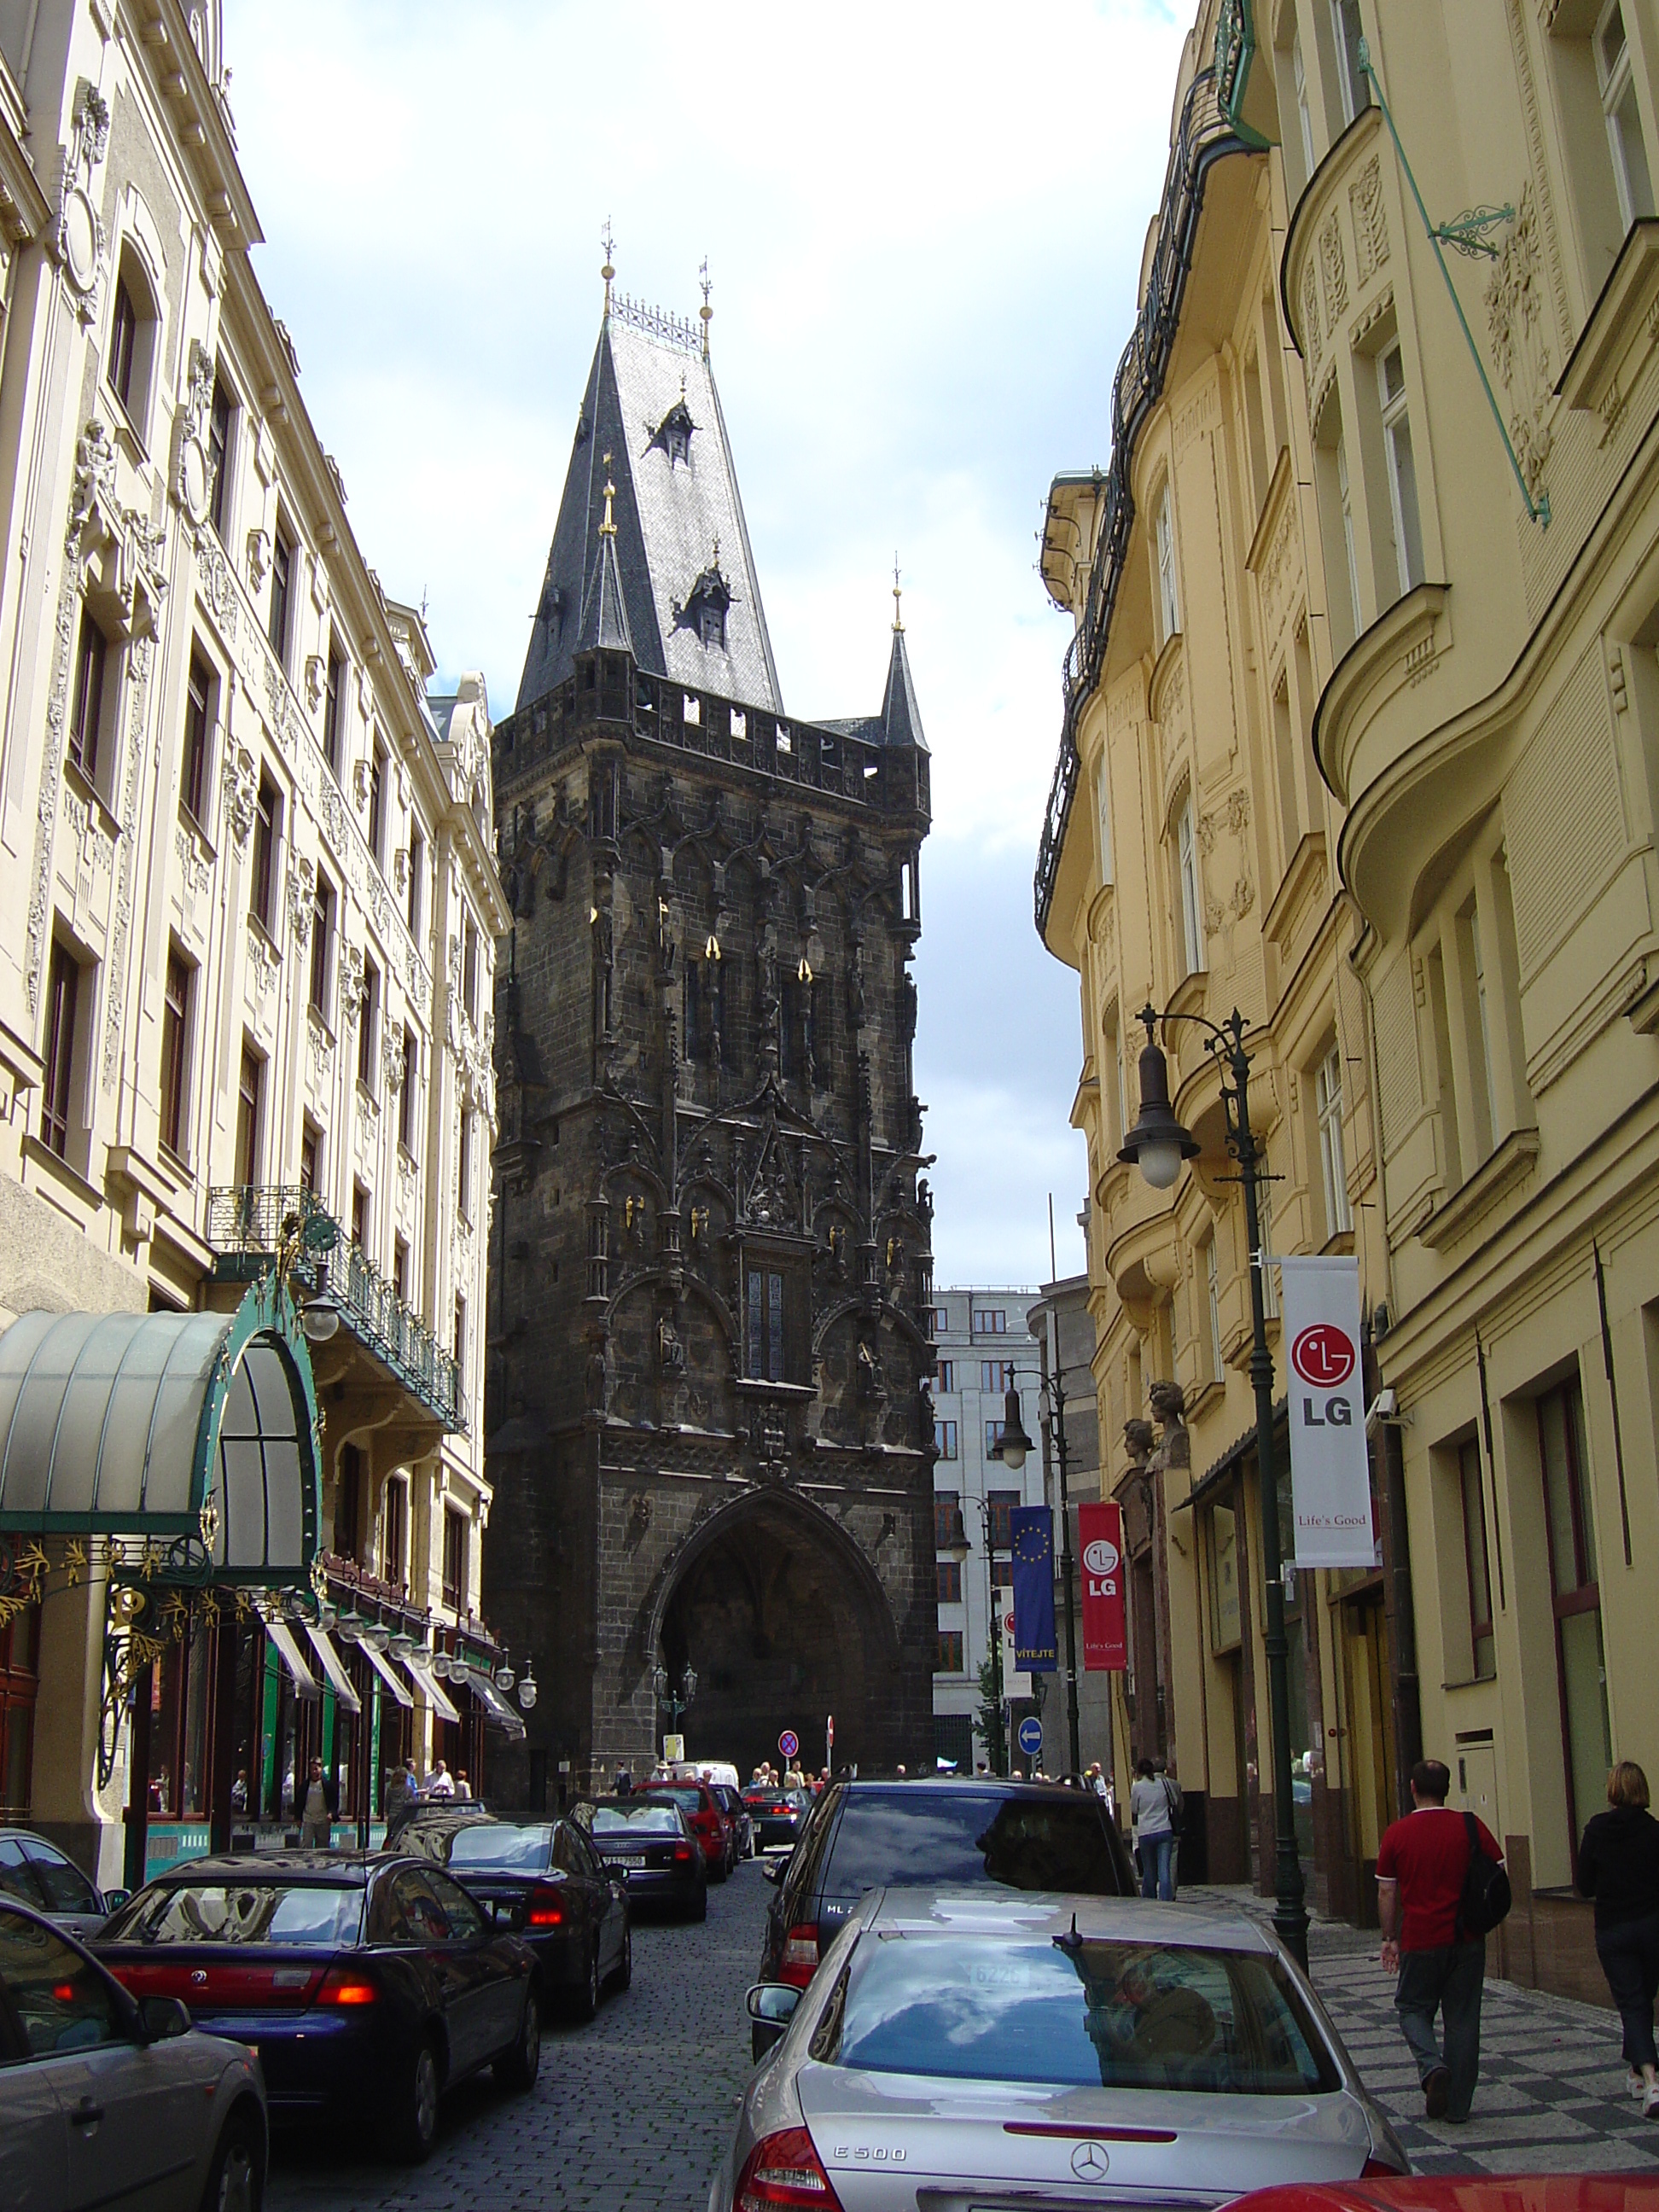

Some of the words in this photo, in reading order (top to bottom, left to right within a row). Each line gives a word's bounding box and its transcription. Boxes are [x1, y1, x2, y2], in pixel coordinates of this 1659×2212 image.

[1302, 1396, 1353, 1427] LG
[1298, 1515, 1331, 1527] Life's
[1334, 1514, 1367, 1526] Good
[1089, 1579, 1116, 1597] LG
[1016, 1648, 1056, 1659] VÍTEJTE
[827, 1905, 844, 1914] ML
[834, 2145, 849, 2158] E
[854, 2146, 907, 2162] 500
